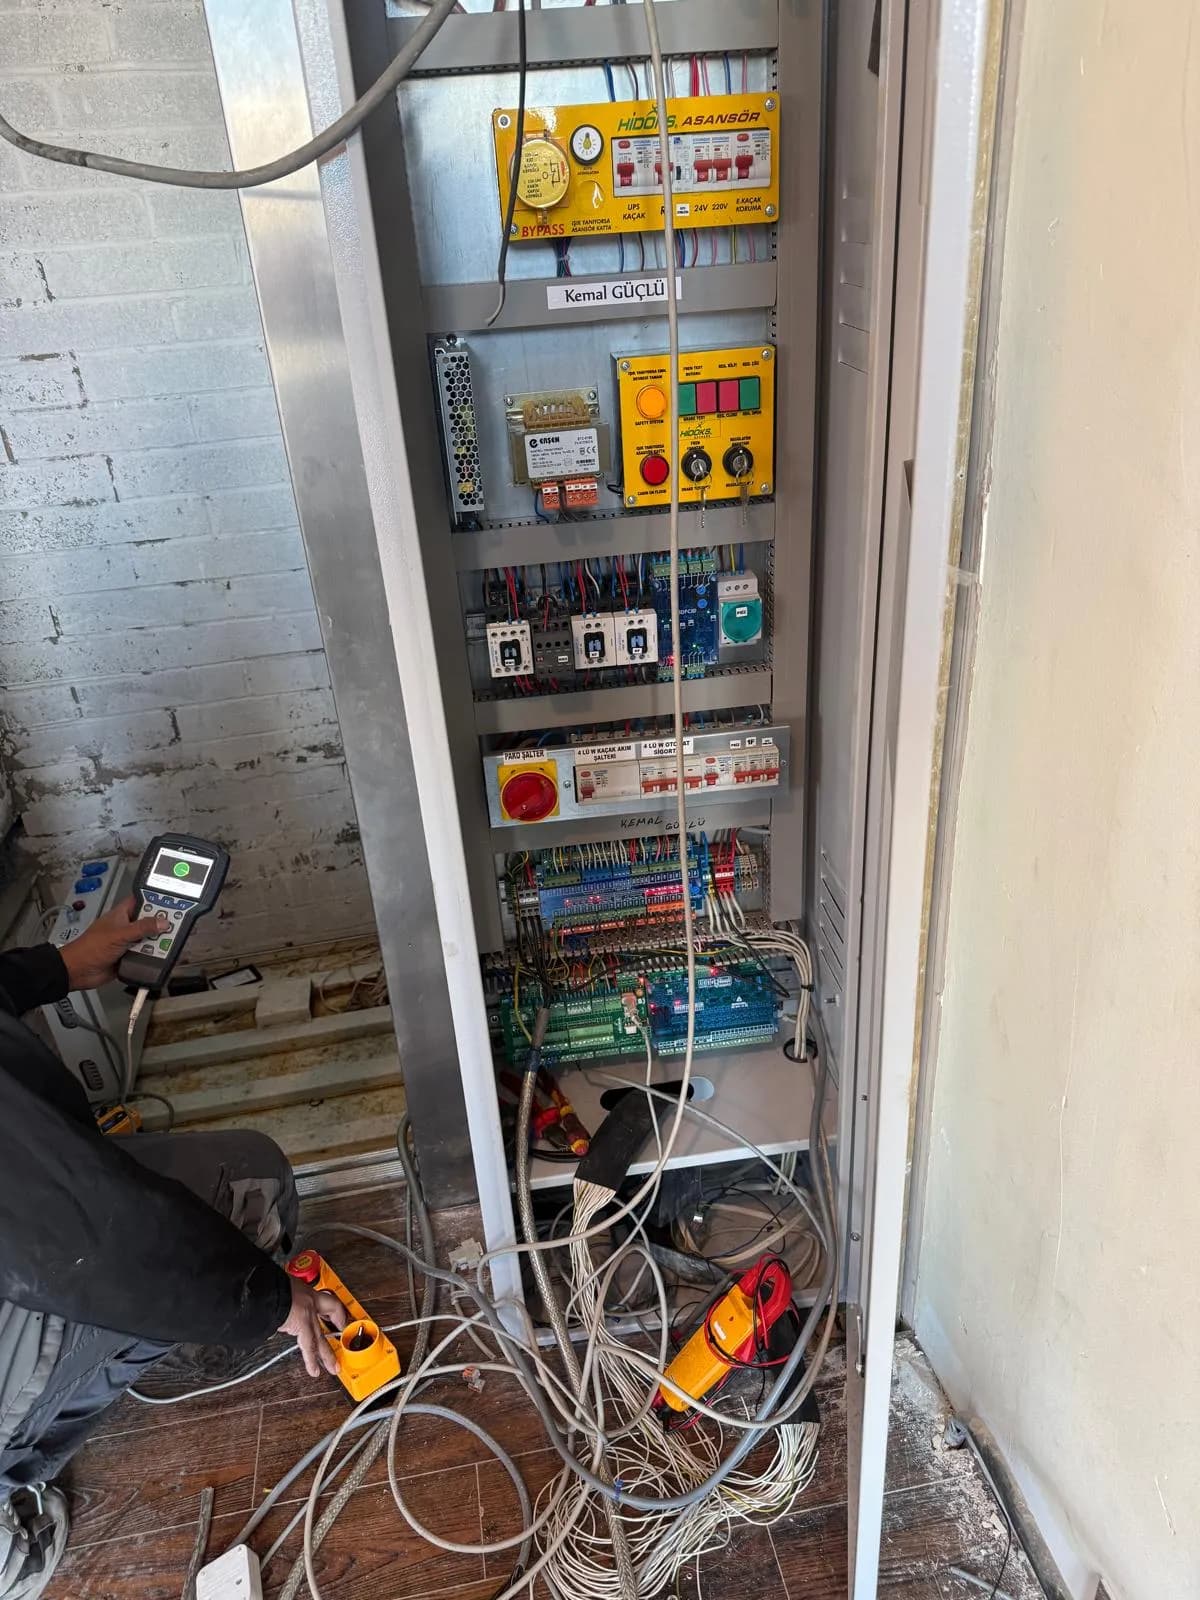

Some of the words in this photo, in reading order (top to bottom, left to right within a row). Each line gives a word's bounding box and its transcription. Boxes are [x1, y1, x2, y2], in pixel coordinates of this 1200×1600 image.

[682, 110, 761, 127] ASANSÖR
[694, 204, 709, 212] 24V
[622, 212, 646, 220] KAÇAK
[521, 223, 565, 238] BYPASS
[564, 285, 607, 303] Kemal
[611, 279, 665, 301] GÜÇLÜ
[504, 751, 521, 761] PAKO
[521, 749, 545, 760] ŞALTER
[597, 746, 616, 755] KAÇAK
[620, 815, 663, 829] KEMAL
